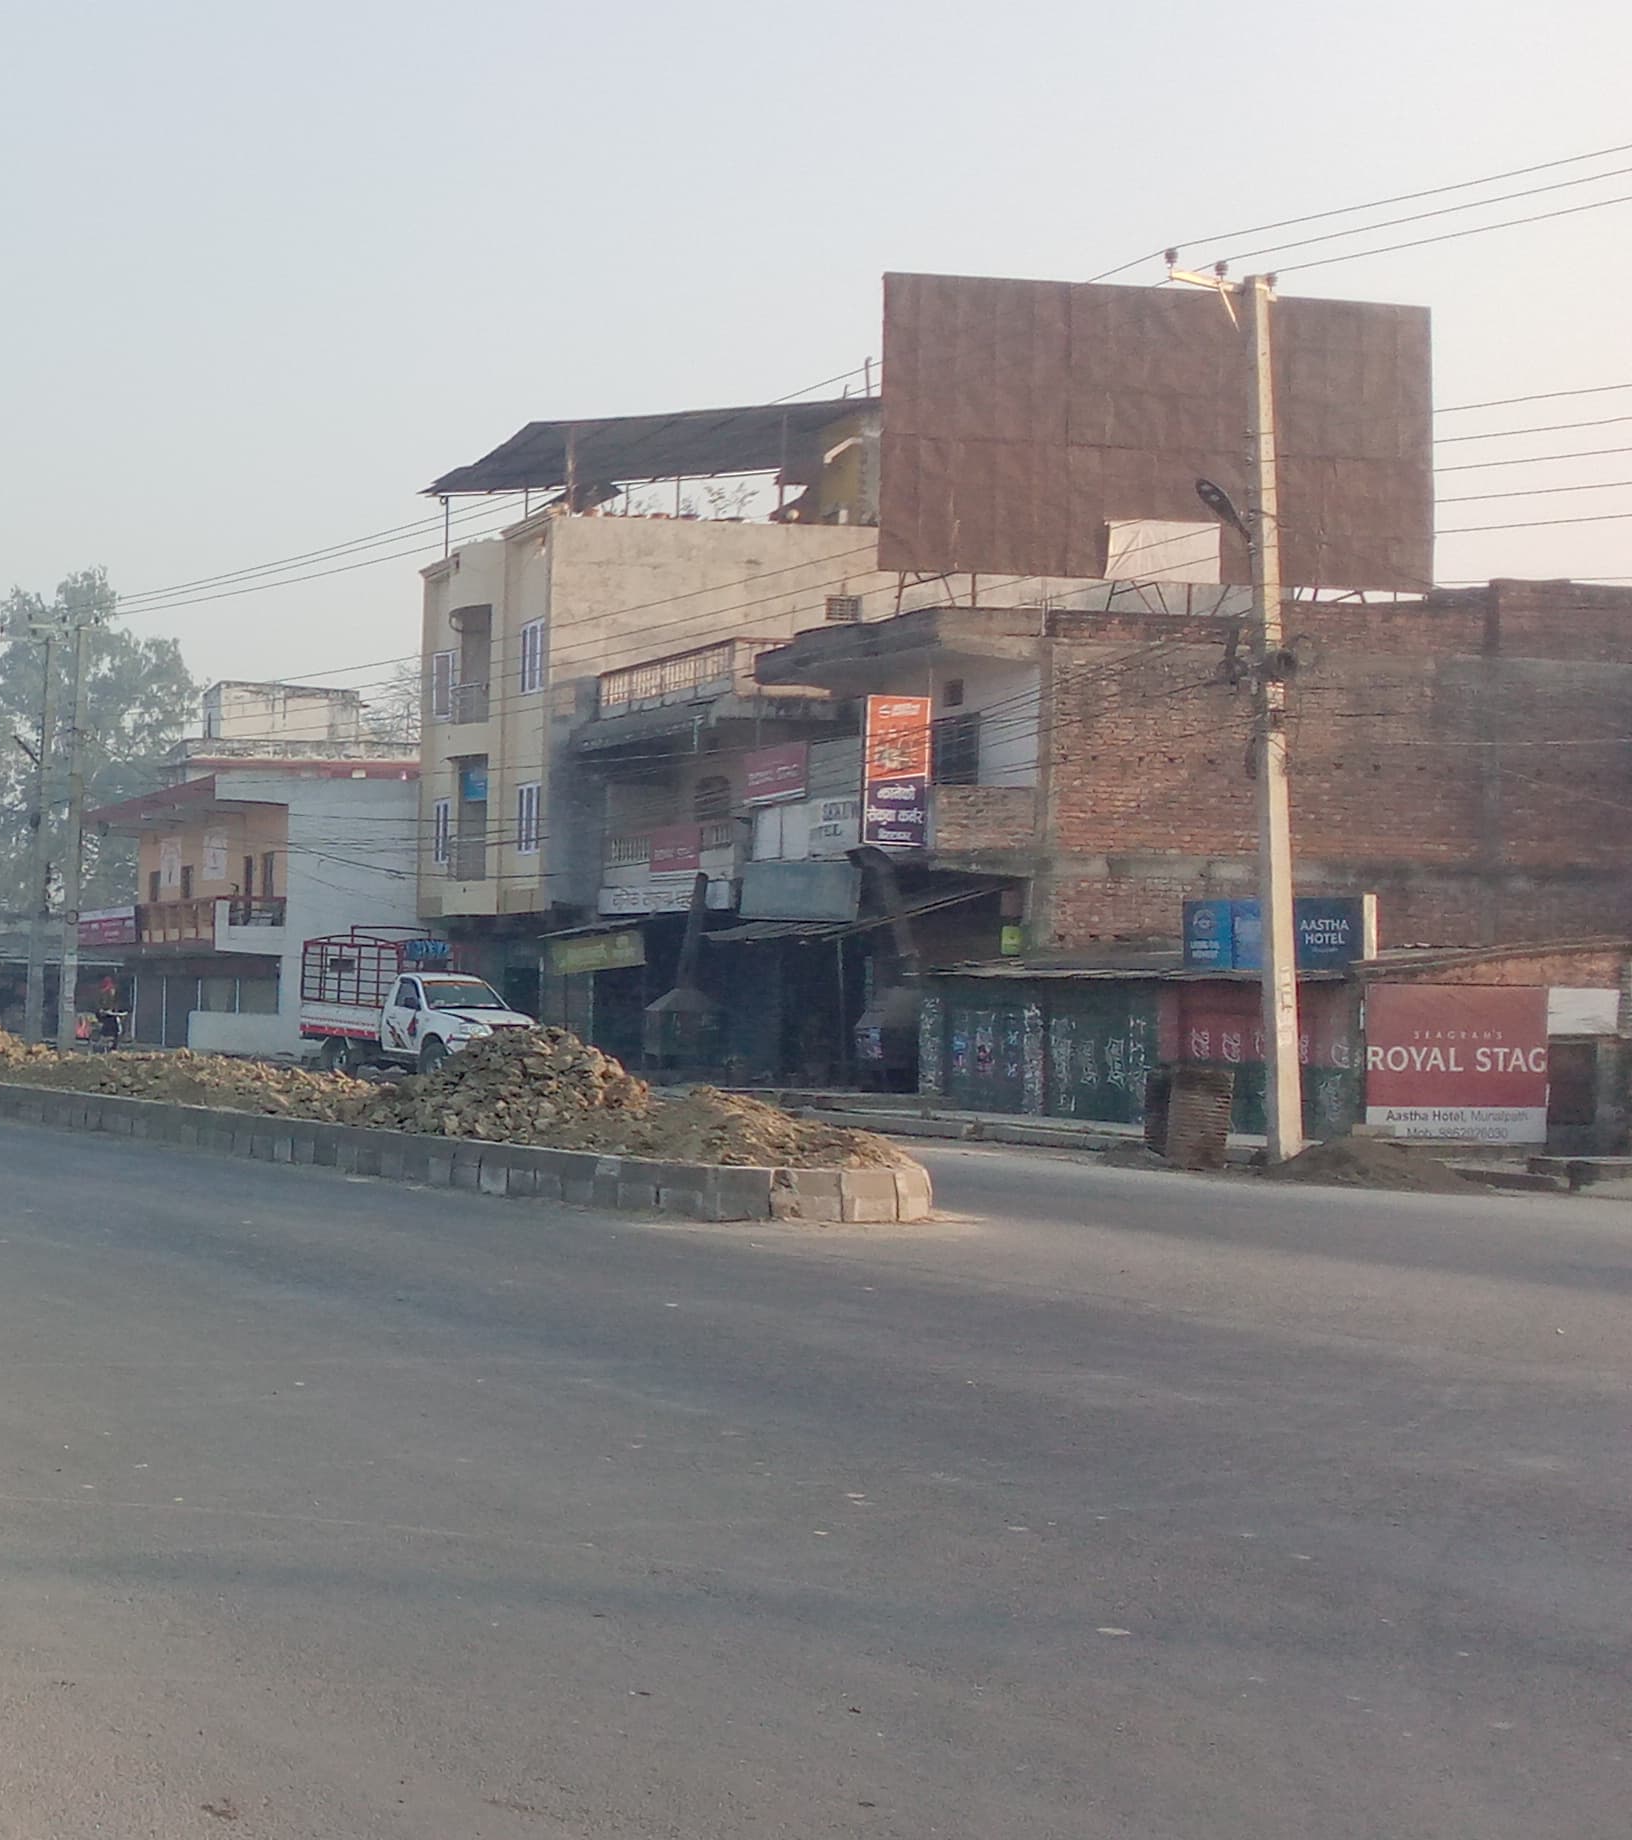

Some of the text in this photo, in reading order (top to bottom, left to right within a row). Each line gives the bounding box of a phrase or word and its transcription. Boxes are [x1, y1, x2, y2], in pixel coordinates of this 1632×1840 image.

[1300, 920, 1350, 931] AASTHA
[1305, 933, 1346, 945] HOTEL
[1413, 1029, 1503, 1040] SEAGRAM'S
[1368, 1046, 1546, 1073] ROYAL STAG
[1386, 1110, 1429, 1122] Aastha
